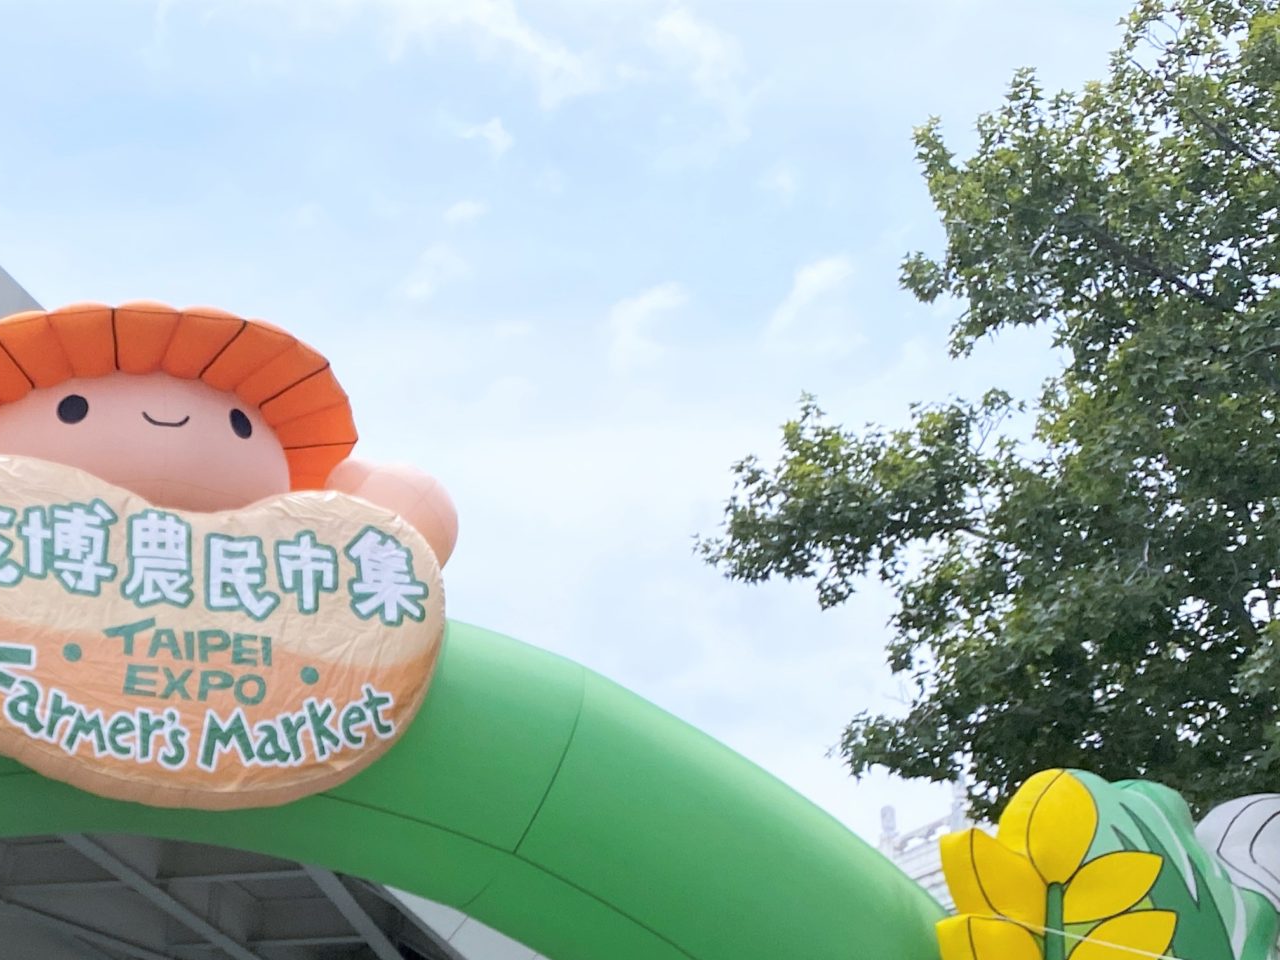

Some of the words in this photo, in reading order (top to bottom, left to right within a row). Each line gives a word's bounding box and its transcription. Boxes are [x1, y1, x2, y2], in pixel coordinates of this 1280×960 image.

[103, 617, 273, 667] TAIPEI
[122, 664, 267, 706] EXPO
[198, 686, 397, 773] Market
